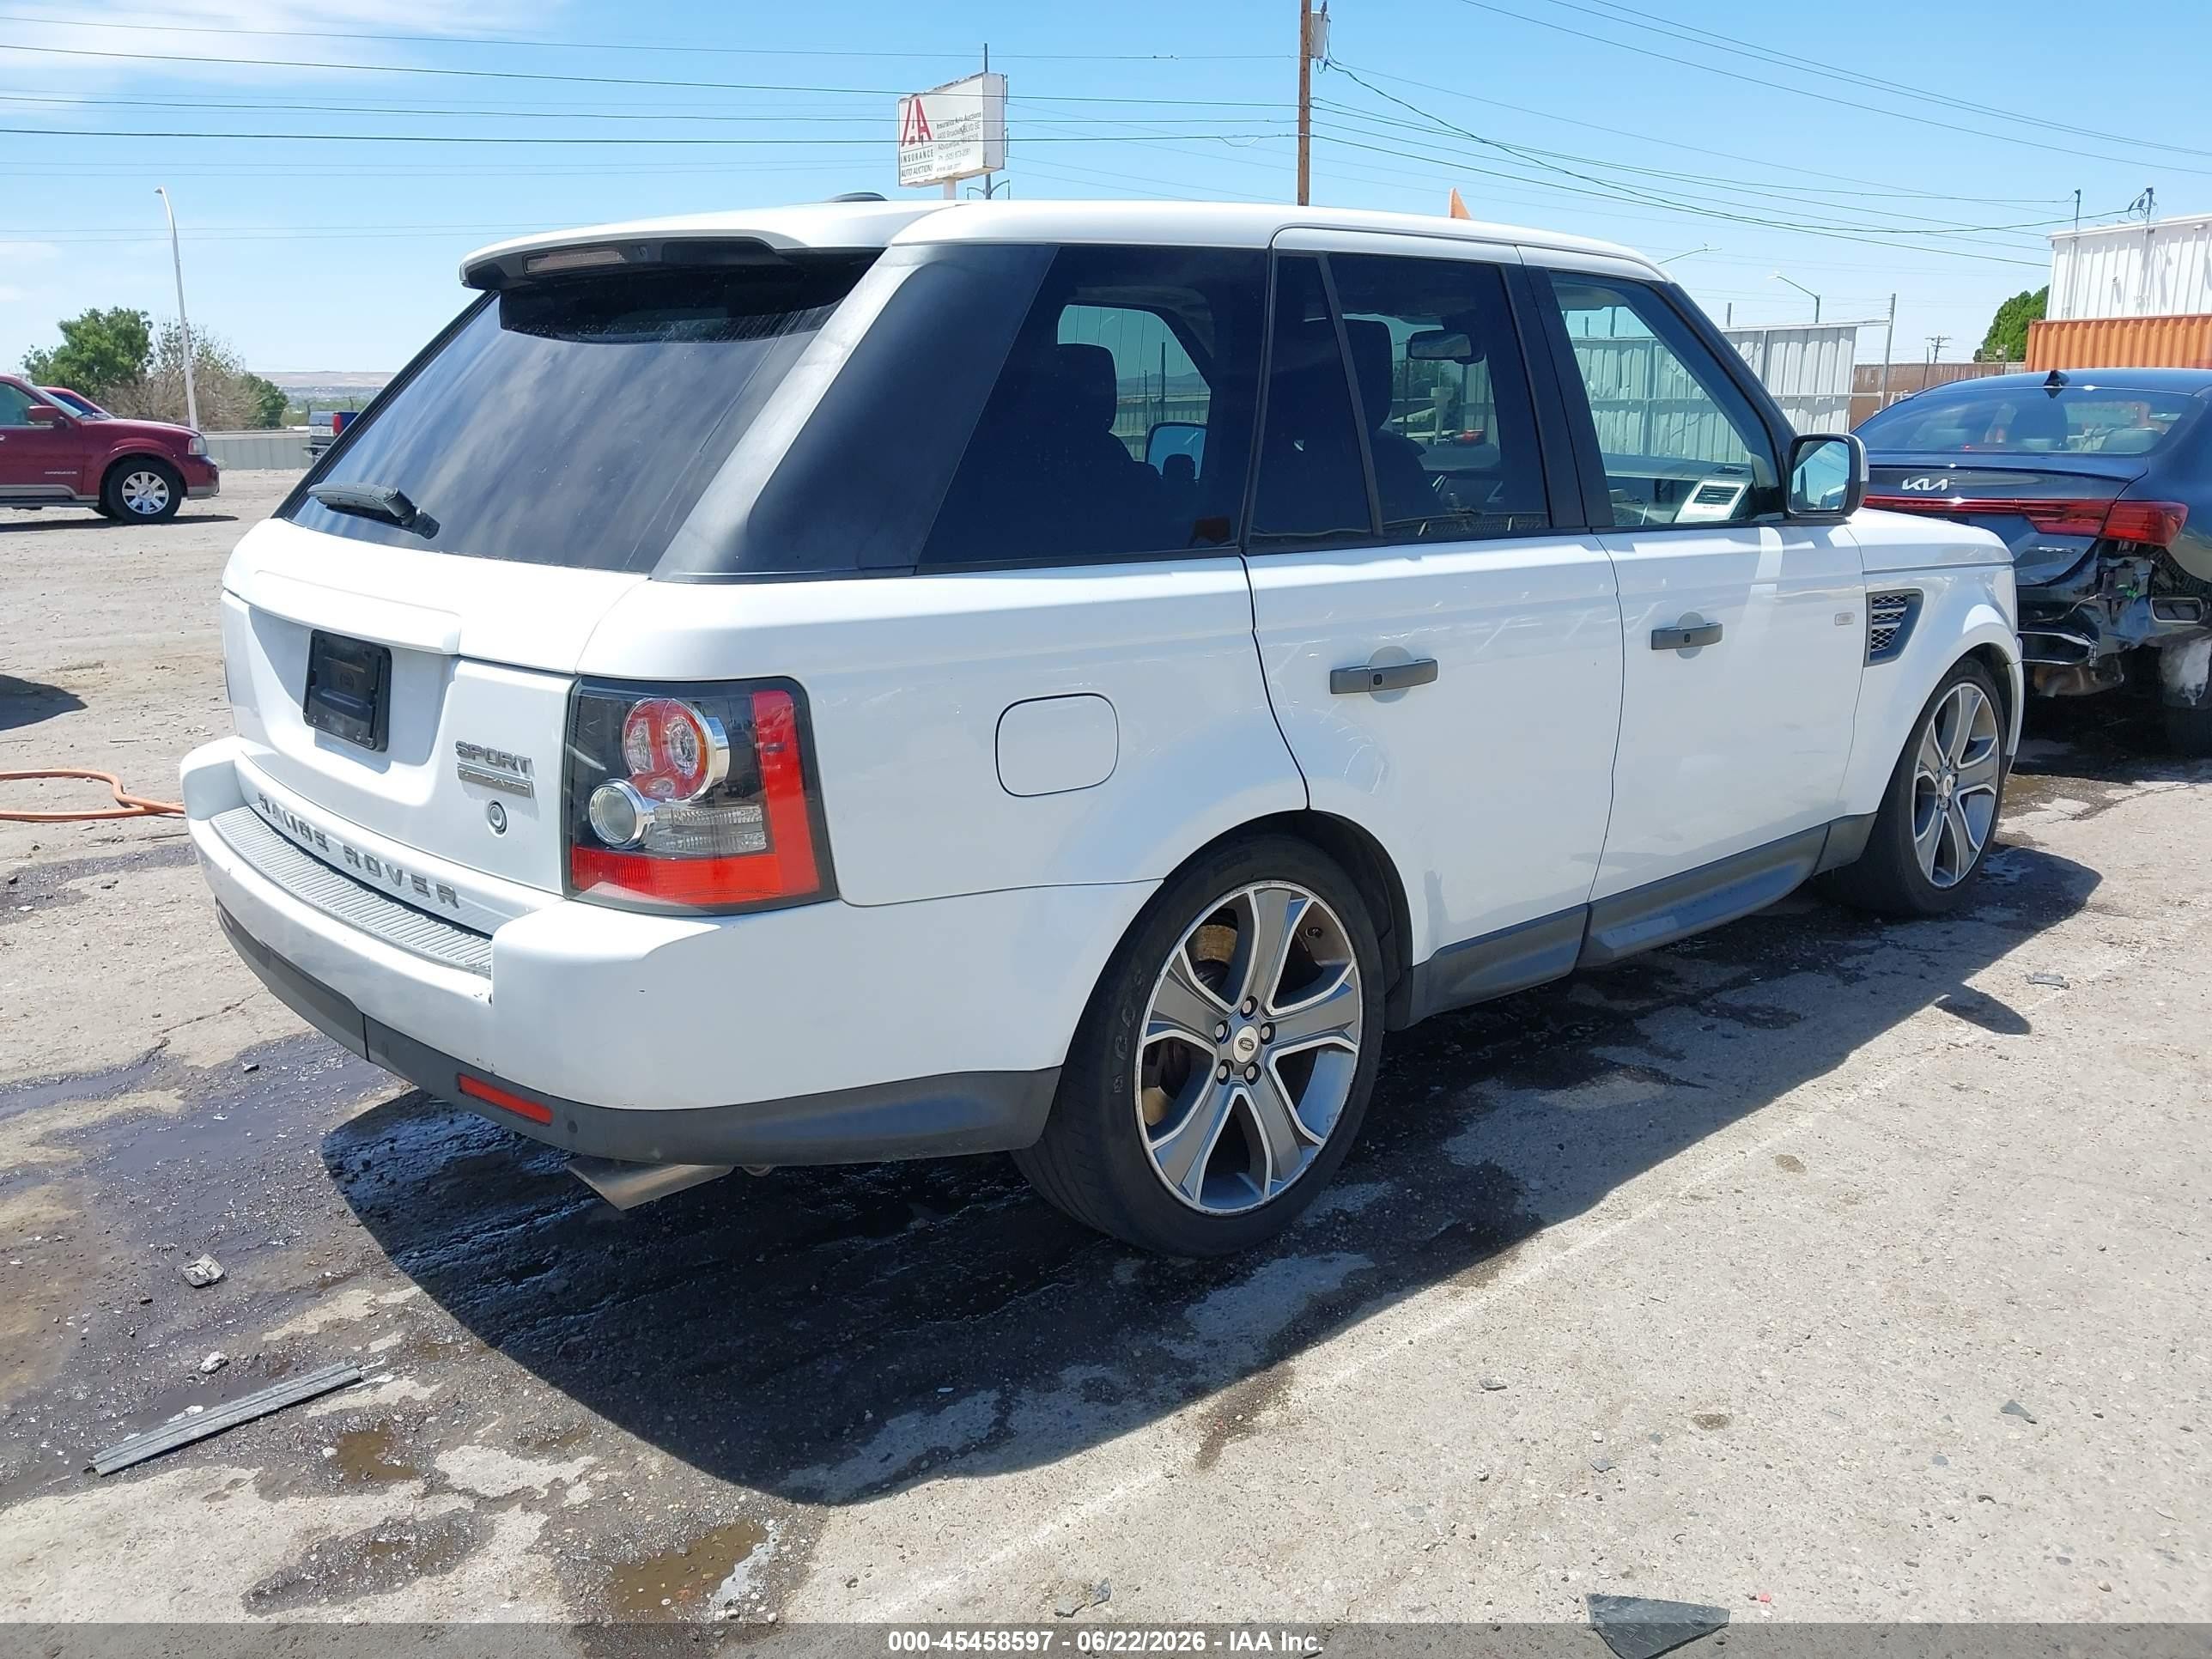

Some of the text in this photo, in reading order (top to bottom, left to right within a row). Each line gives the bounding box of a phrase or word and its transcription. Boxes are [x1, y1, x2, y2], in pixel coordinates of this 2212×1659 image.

[901, 149, 933, 163] INSURANCE
[901, 167, 913, 178] AUTO
[913, 163, 933, 176] AUCTIONS
[1902, 477, 1948, 491] KIA
[455, 740, 532, 773] SPORT
[343, 844, 460, 908] ROVER
